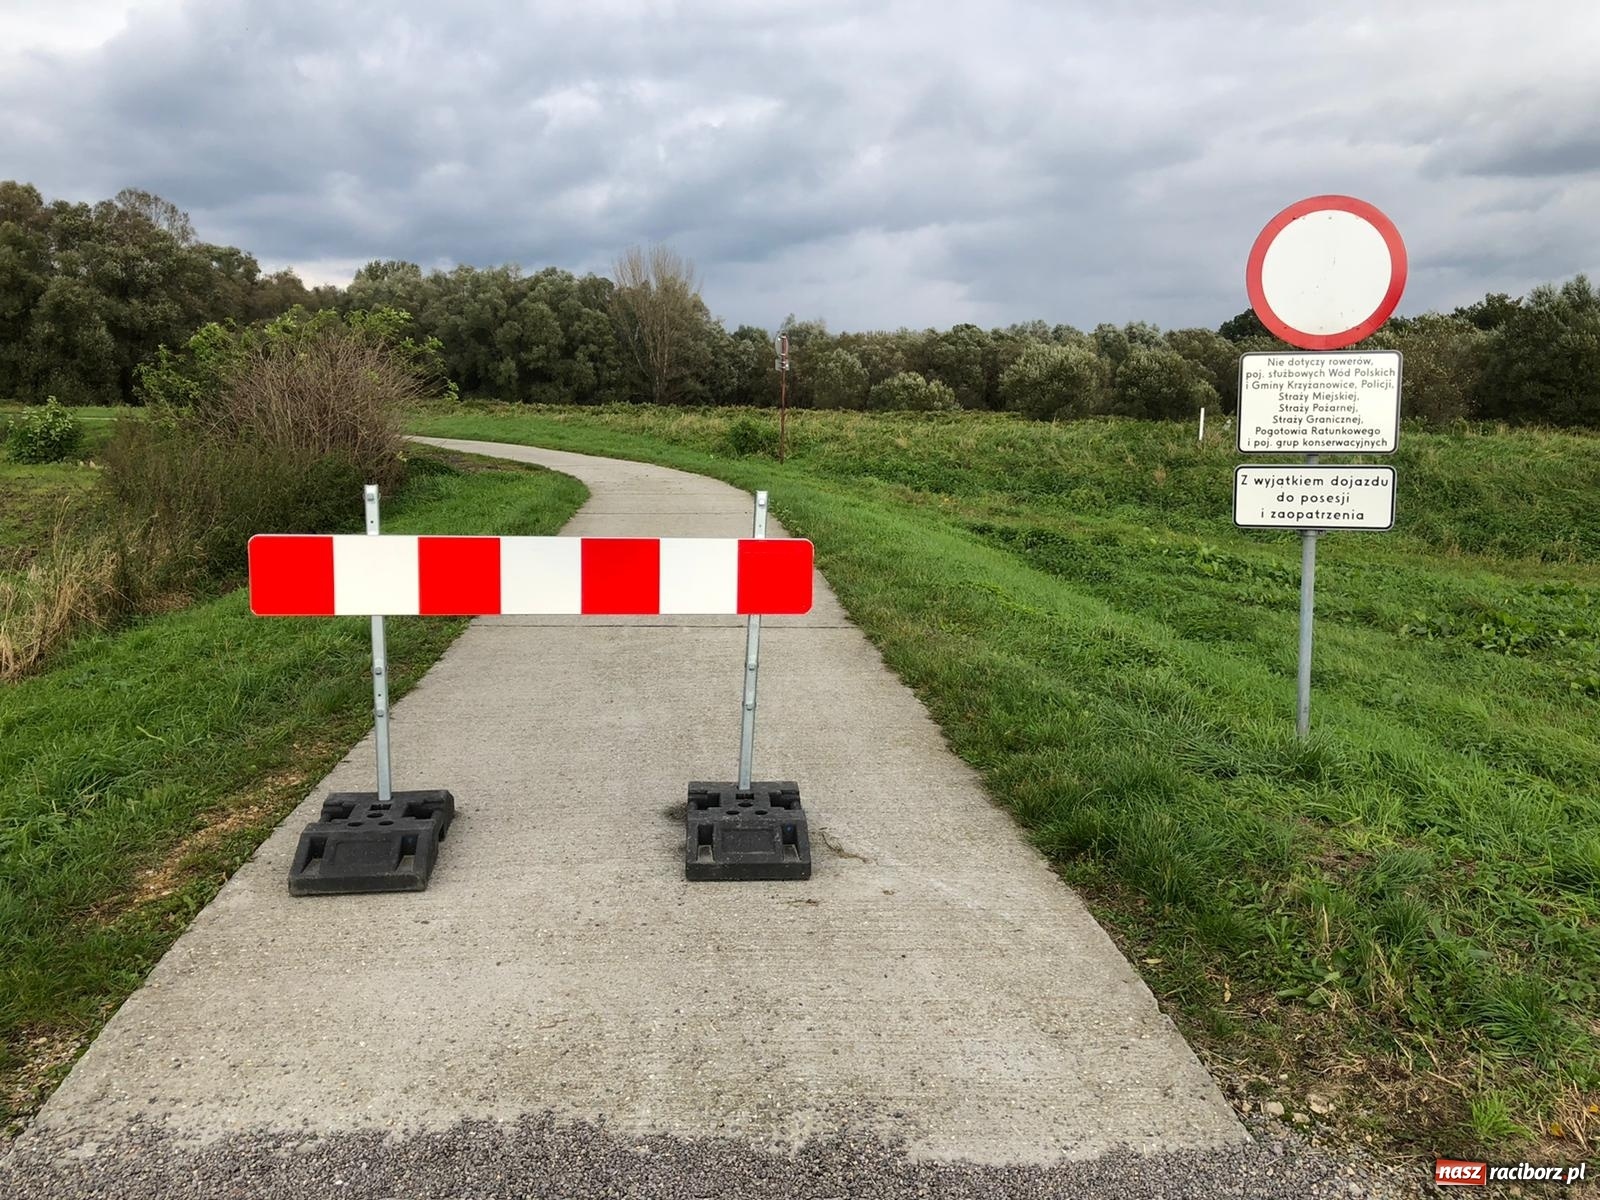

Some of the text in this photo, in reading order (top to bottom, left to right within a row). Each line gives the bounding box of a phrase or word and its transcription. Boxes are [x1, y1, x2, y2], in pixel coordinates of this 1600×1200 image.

[1268, 358, 1284, 366] Nie
[1288, 357, 1326, 368] dotyczy
[1246, 368, 1395, 380] poj. służbowych Wód Polskich
[1252, 381, 1284, 390] Gminy
[1279, 392, 1309, 402] Straży
[1279, 404, 1309, 414] Straży
[1272, 415, 1303, 425] Straży
[1256, 427, 1380, 437] Pogotowia Ratunkowego
[1254, 439, 1272, 448] poj.
[1276, 439, 1299, 448] grup
[1303, 439, 1387, 448] konserwacyjnych
[1241, 475, 1248, 485] Z
[1331, 476, 1388, 488] dojazdu
[1277, 492, 1350, 505] do posesji
[1261, 508, 1364, 521] i zaopatrzenia
